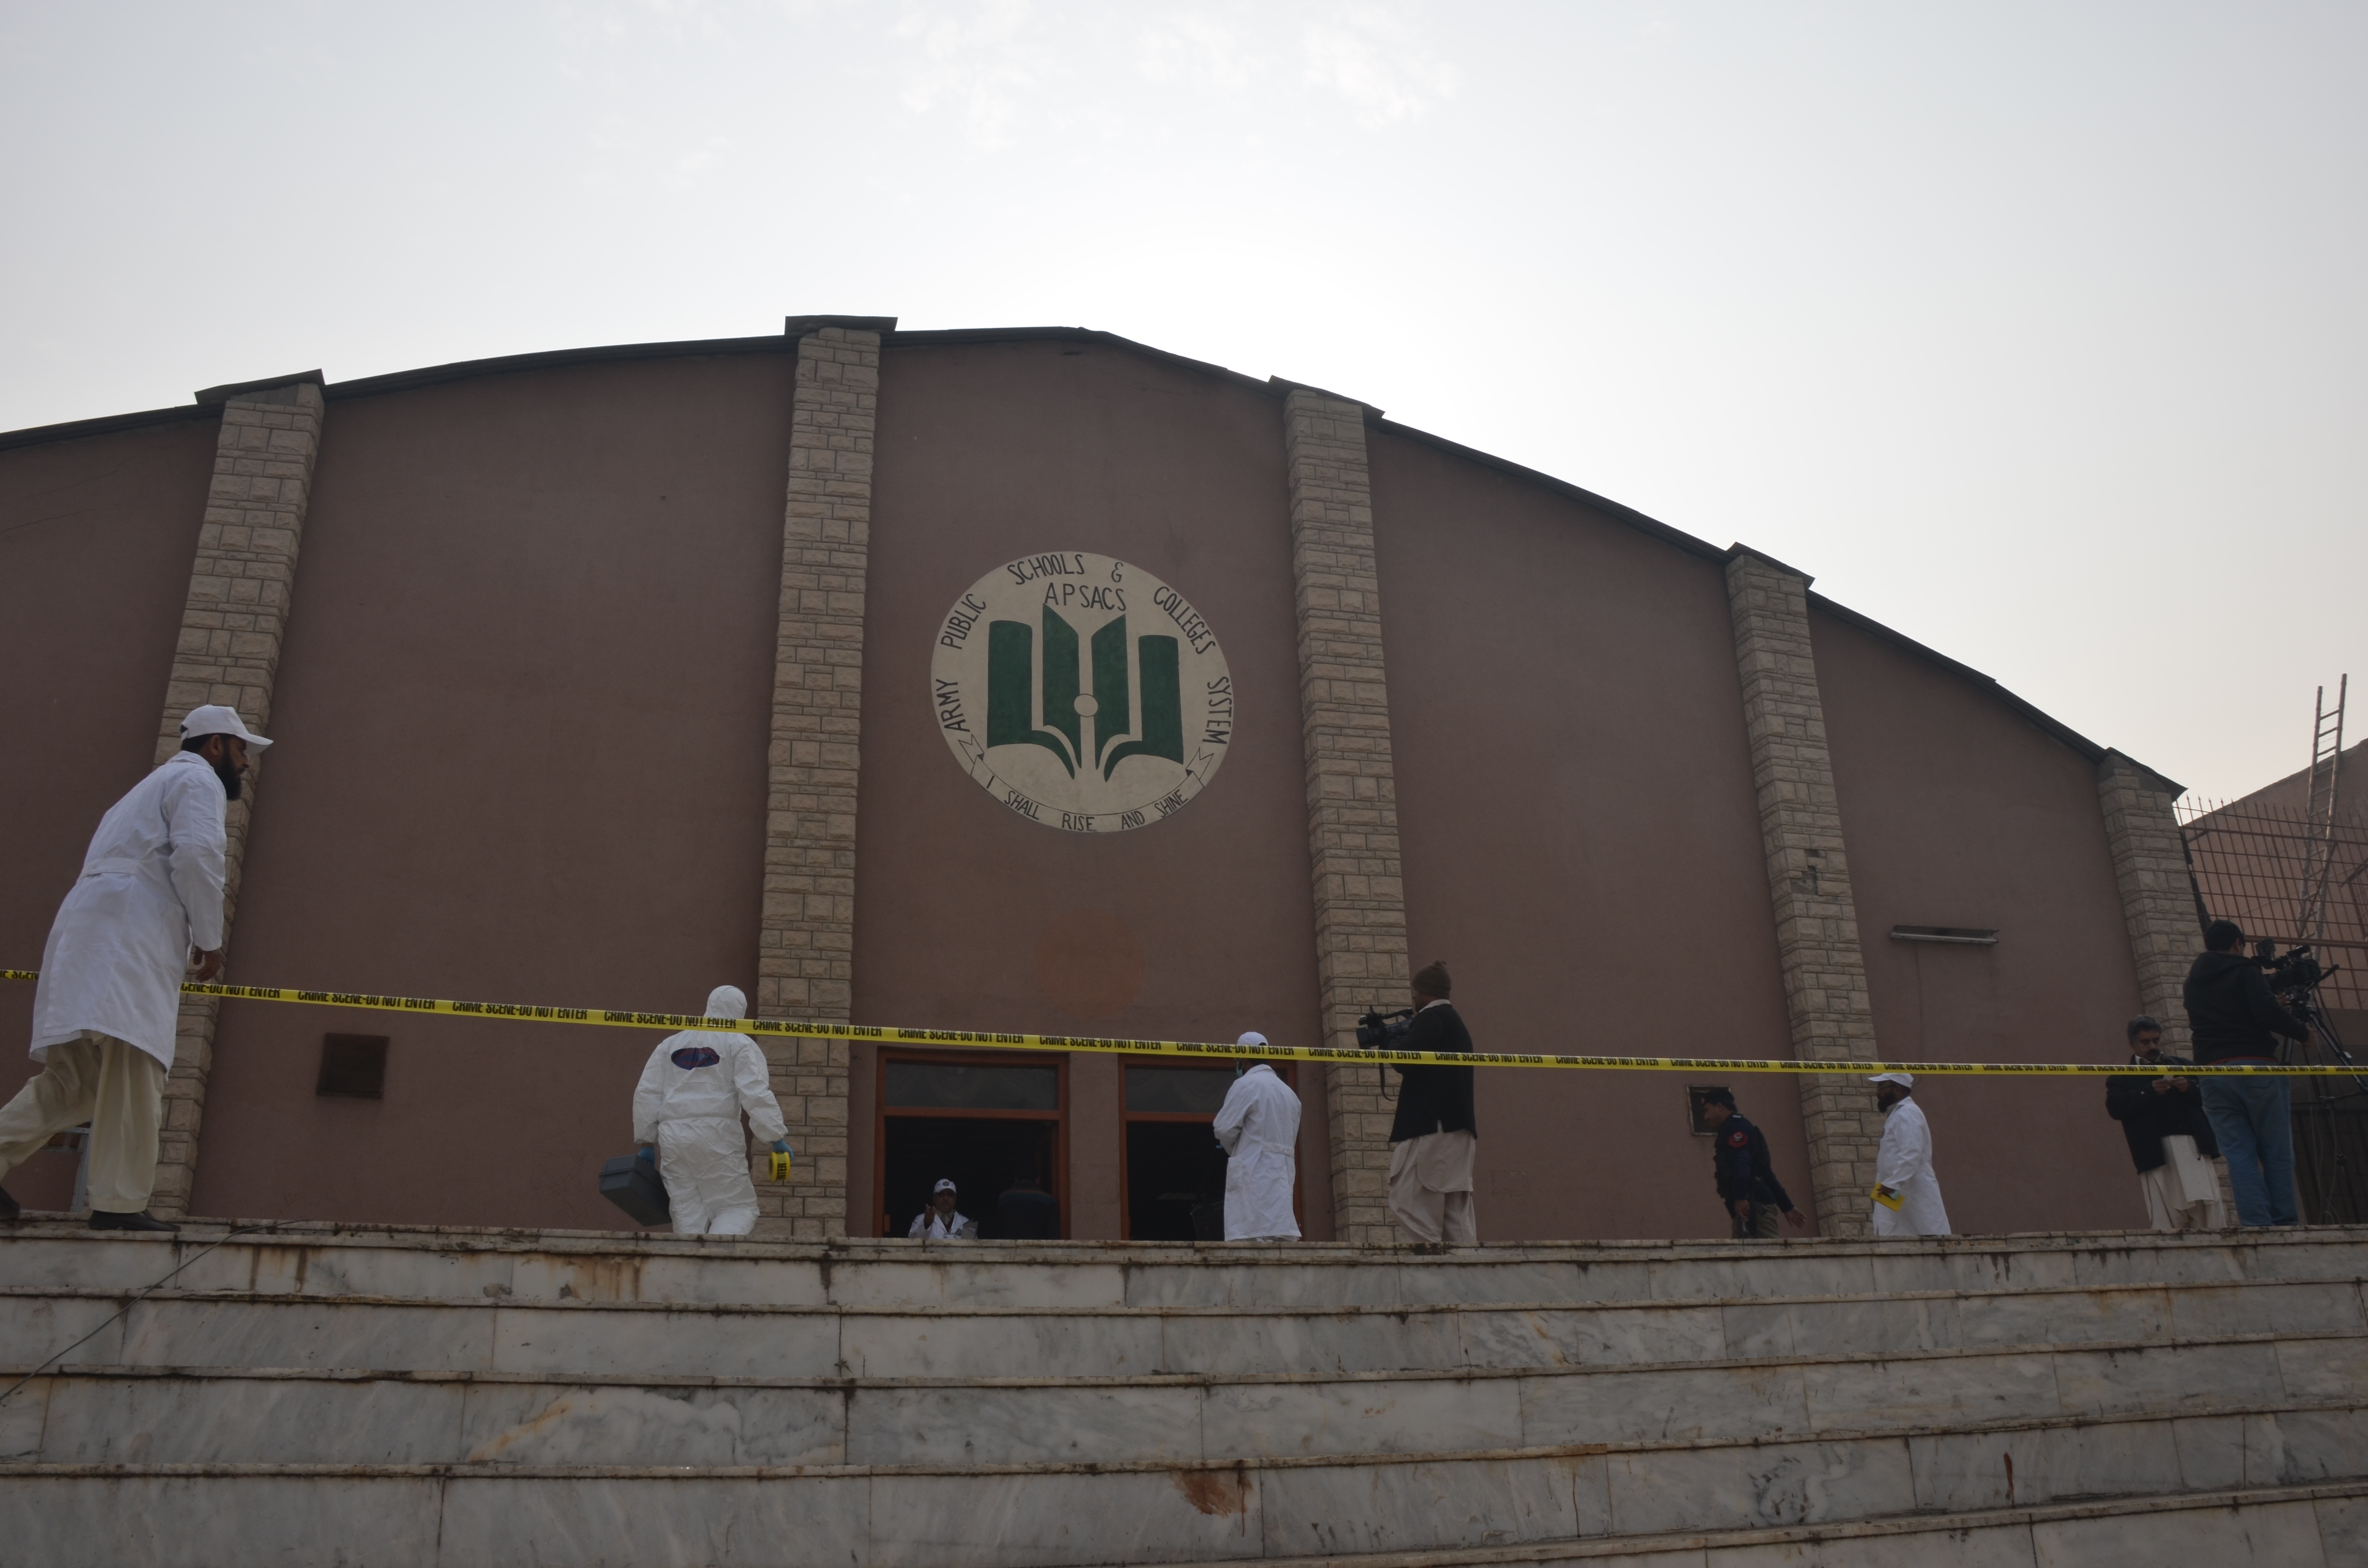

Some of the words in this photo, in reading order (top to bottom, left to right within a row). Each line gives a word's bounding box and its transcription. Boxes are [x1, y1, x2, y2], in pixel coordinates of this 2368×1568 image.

[1007, 553, 1085, 585] SCHOOLS
[1044, 582, 1127, 612] APSACS
[940, 593, 987, 650] PUBLIC
[1153, 586, 1216, 655] COLLEGES
[936, 678, 971, 733] ARMY
[1202, 676, 1233, 745] SYSTEM
[986, 775, 995, 789] I
[1003, 790, 1039, 821] SHALL
[1061, 812, 1097, 832] RISE
[1121, 810, 1146, 830] AND
[1154, 789, 1189, 818] SHINE
